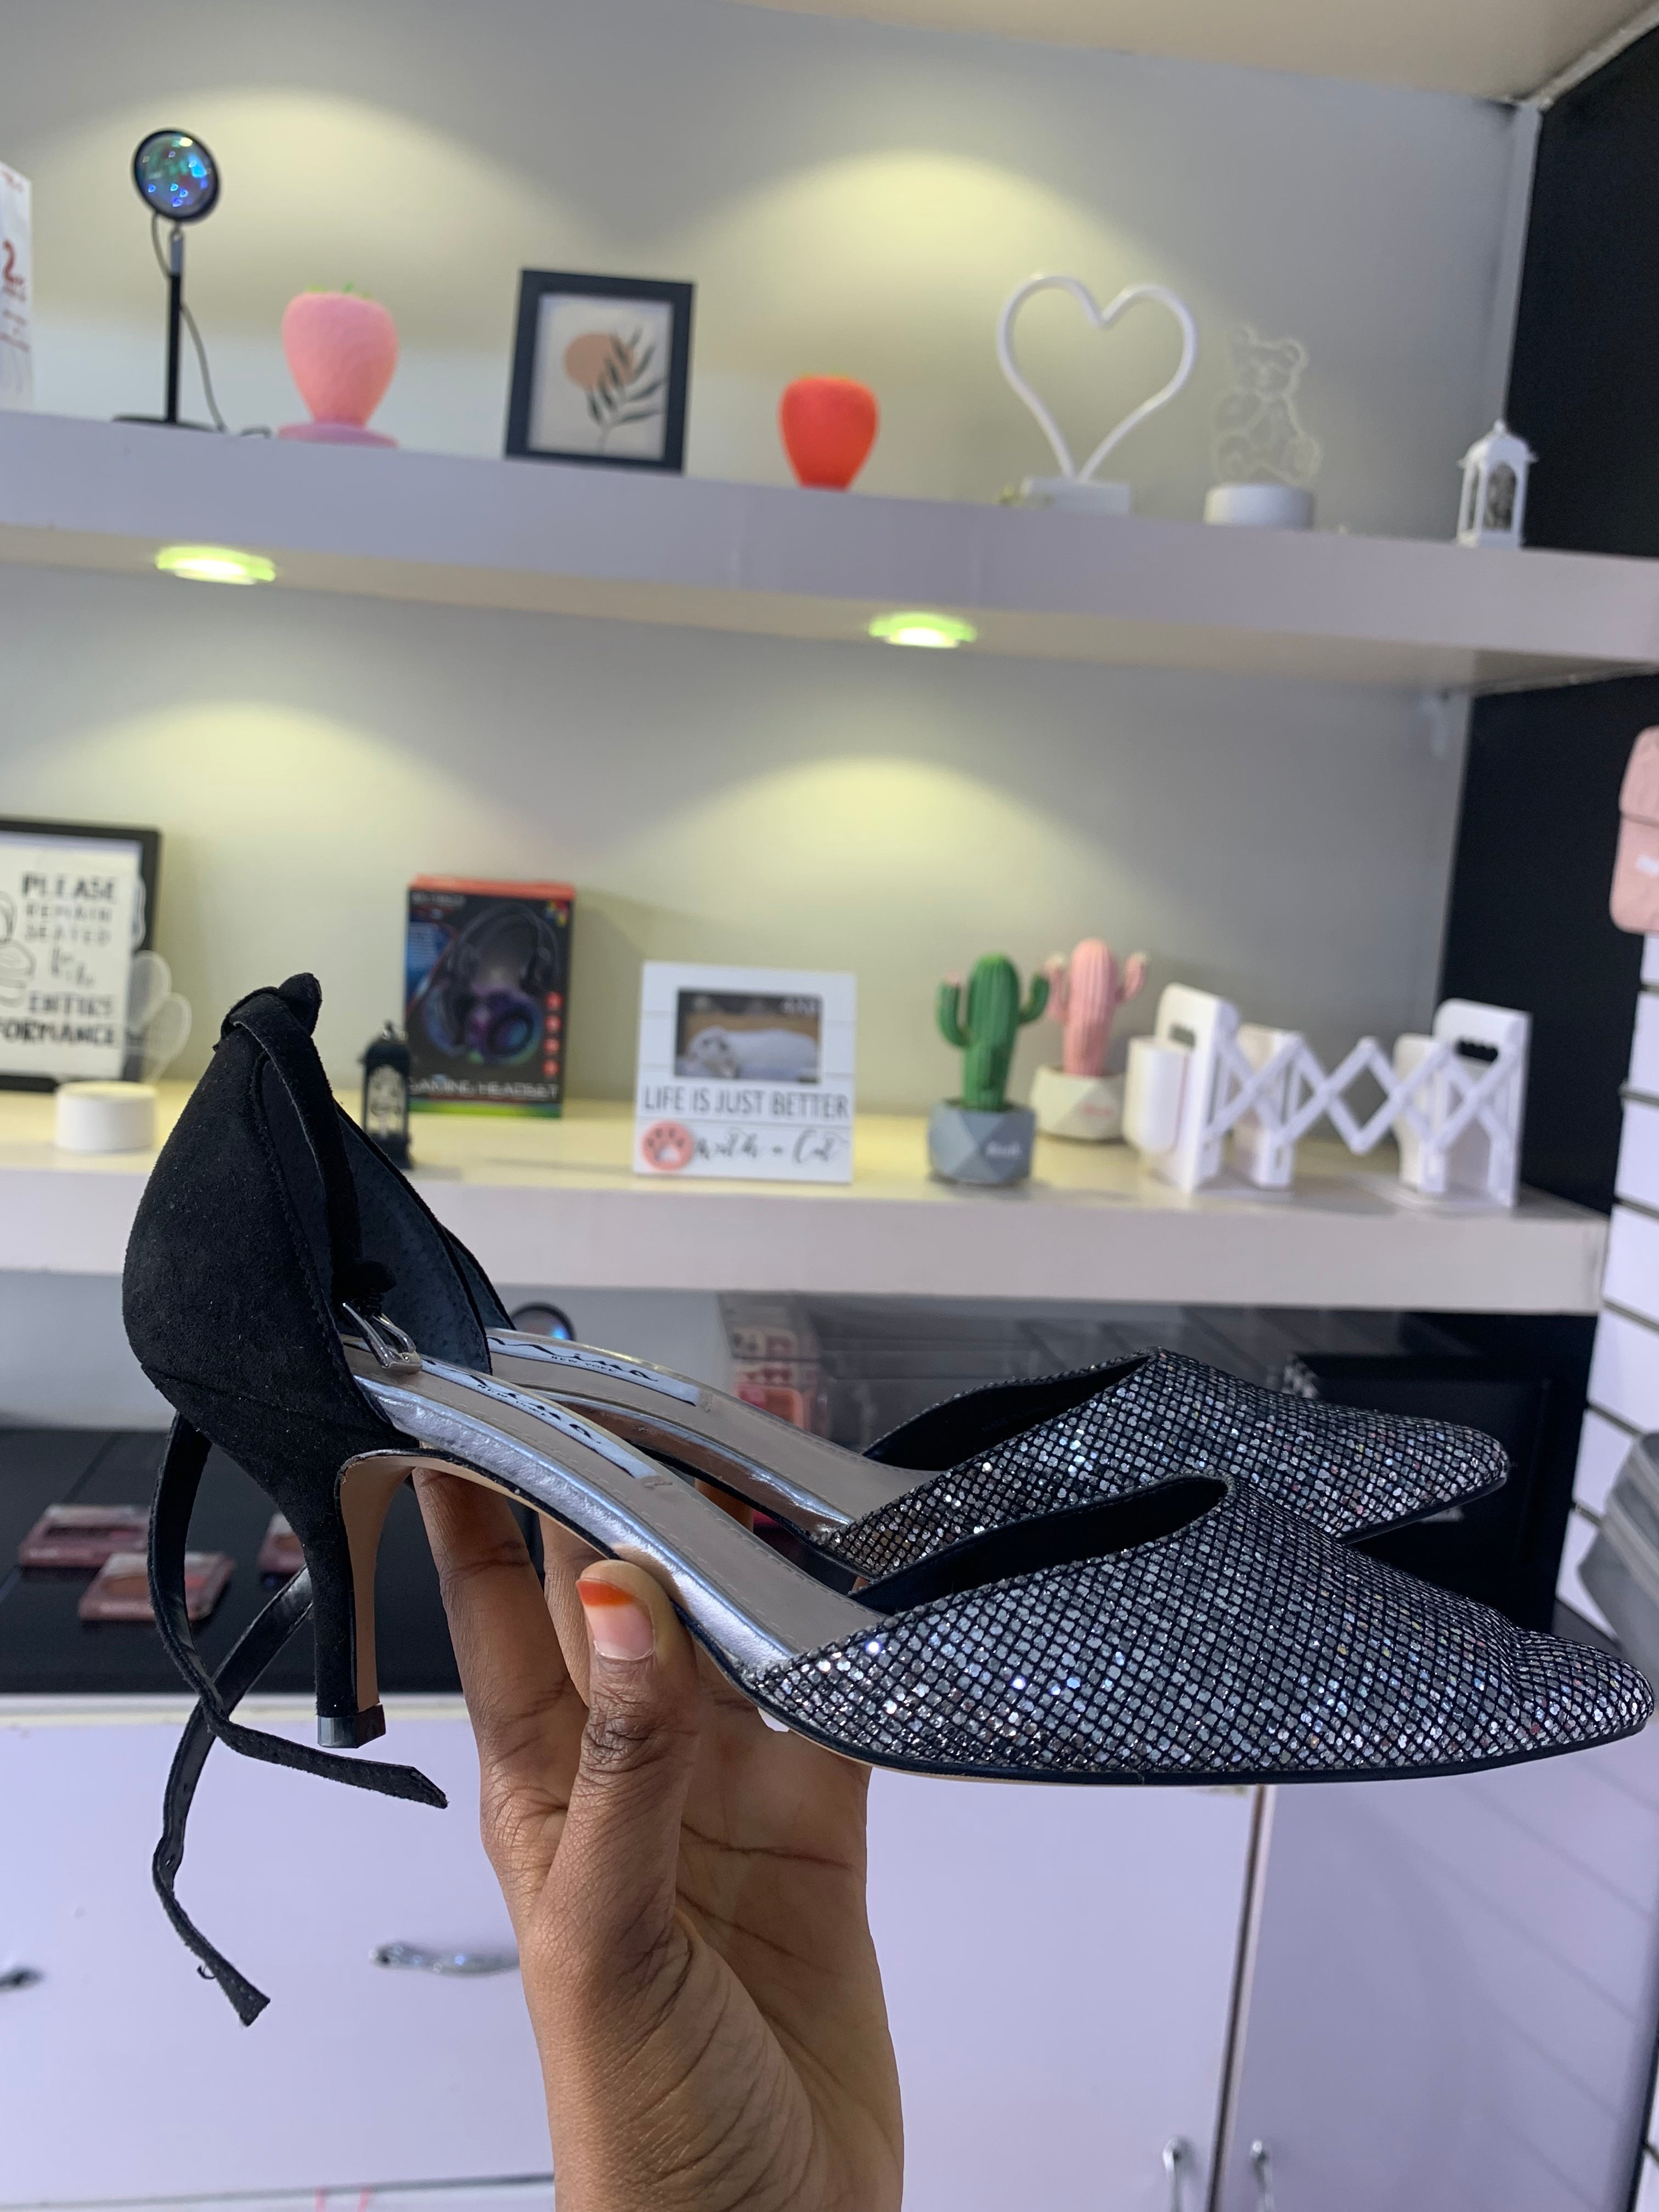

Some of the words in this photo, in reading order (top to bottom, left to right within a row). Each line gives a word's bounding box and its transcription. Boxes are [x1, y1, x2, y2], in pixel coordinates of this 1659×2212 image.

[0, 1018, 115, 1045] ORMANCE
[644, 1084, 685, 1112] LIFE
[692, 1085, 710, 1114] IS
[715, 1088, 765, 1116] JUST
[772, 1090, 849, 1119] BETTER
[551, 1355, 577, 1363] NEW
